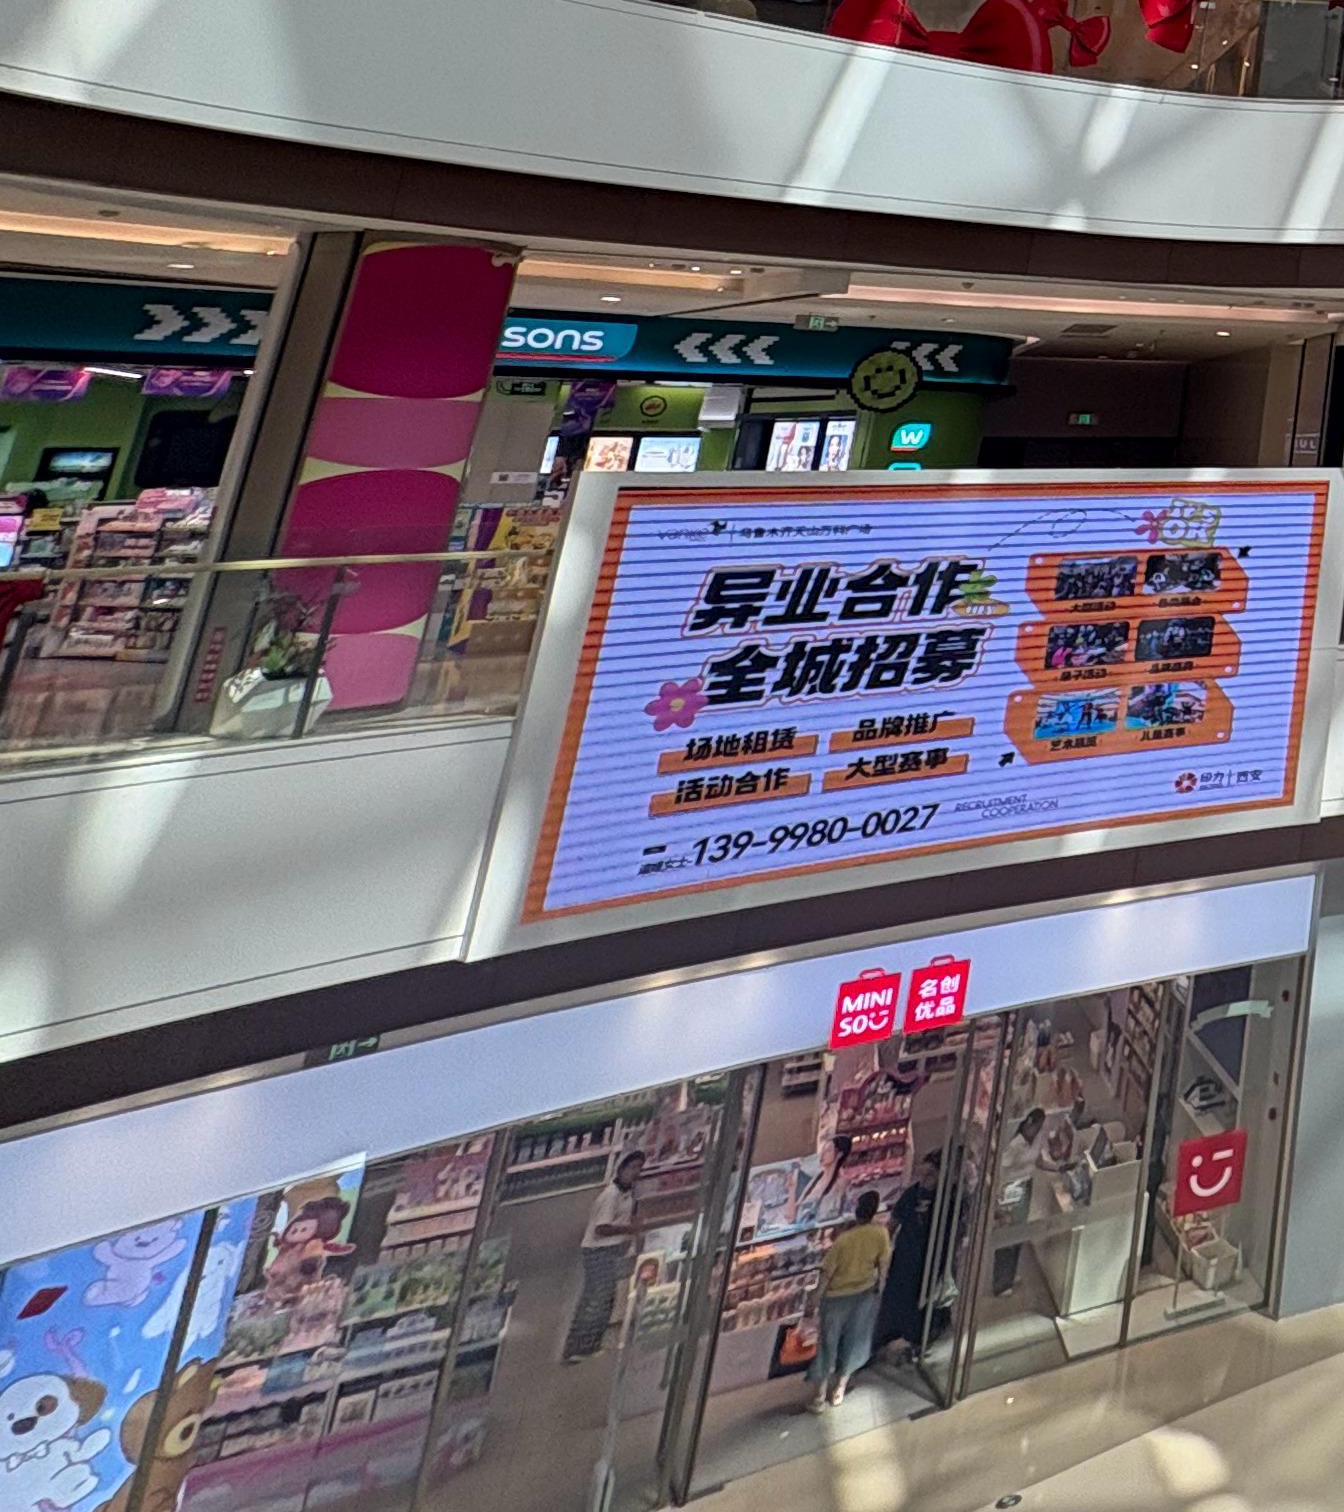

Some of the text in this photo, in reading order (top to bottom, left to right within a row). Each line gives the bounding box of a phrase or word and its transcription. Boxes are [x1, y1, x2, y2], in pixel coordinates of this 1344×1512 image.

[689, 556, 981, 633] 异业合作
[700, 626, 988, 706] 全城招募
[851, 711, 957, 743] 品牌推广
[683, 727, 797, 762] 场地租赁
[846, 748, 949, 780] 大型赛事
[674, 768, 790, 805] 活动合作
[692, 803, 941, 868] 139-9980-0027
[841, 988, 893, 1014] MINI
[918, 974, 960, 999] 名创
[915, 996, 956, 1022] 优品
